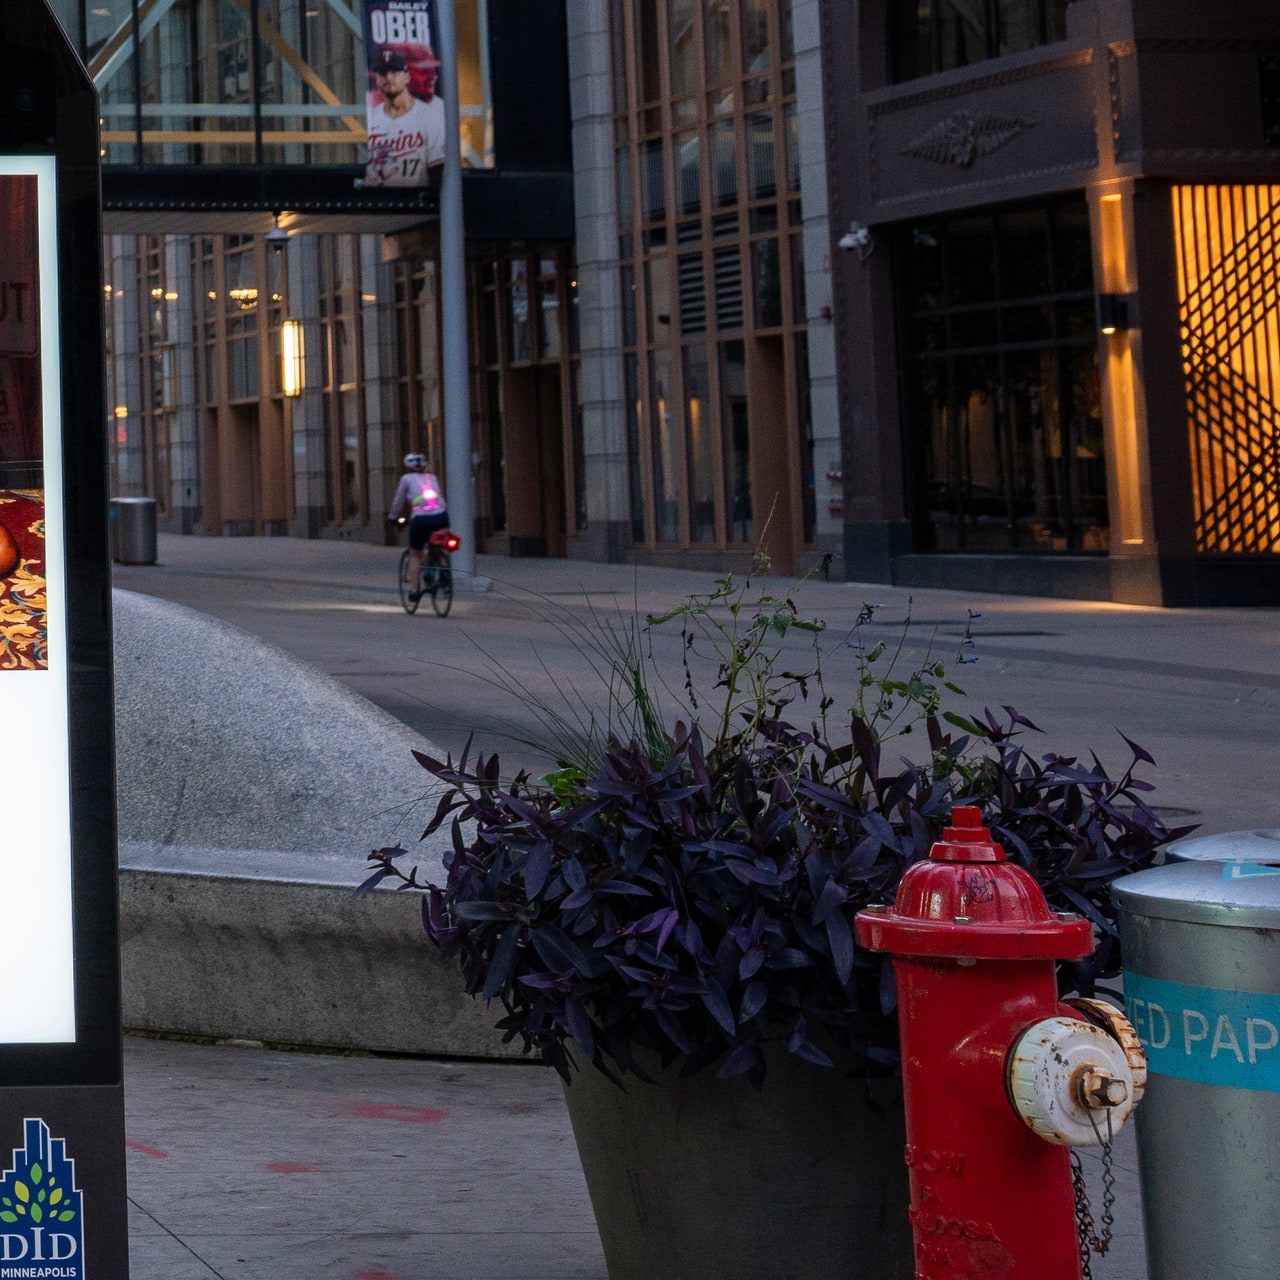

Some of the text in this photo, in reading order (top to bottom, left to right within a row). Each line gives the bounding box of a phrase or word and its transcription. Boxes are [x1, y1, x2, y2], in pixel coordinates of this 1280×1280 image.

[371, 9, 430, 45] OBER
[368, 129, 425, 151] Twins
[402, 158, 420, 176] 17
[1182, 1009, 1279, 1065] PAP
[0, 1226, 77, 1261] DID
[1, 1266, 77, 1278] MINNEAPOLIS
